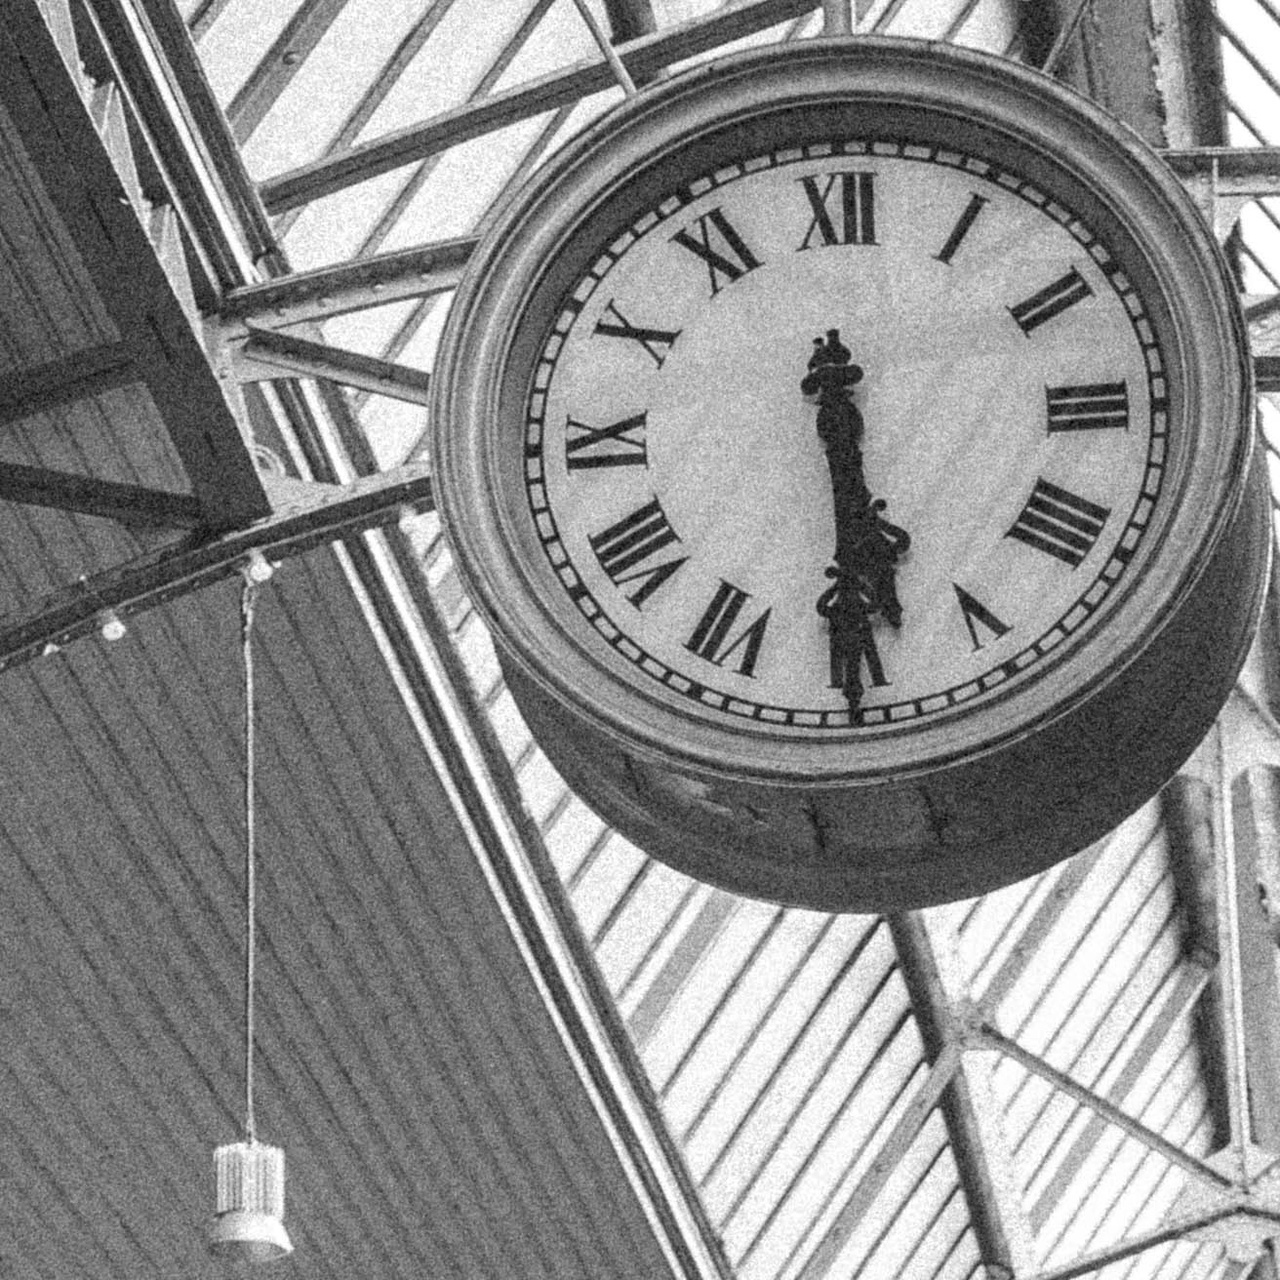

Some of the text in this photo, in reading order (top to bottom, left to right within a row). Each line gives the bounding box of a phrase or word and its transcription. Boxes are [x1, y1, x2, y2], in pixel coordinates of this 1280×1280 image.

[796, 172, 880, 251] XII
[933, 193, 990, 265] I
[669, 207, 765, 298] XI
[592, 299, 683, 369] X
[1005, 265, 1094, 338] II
[566, 410, 648, 474] IX
[1045, 379, 1128, 438] III
[588, 494, 691, 611] VIII
[1004, 476, 1112, 570] IIII
[683, 578, 773, 678] VII
[953, 582, 1012, 652] V
